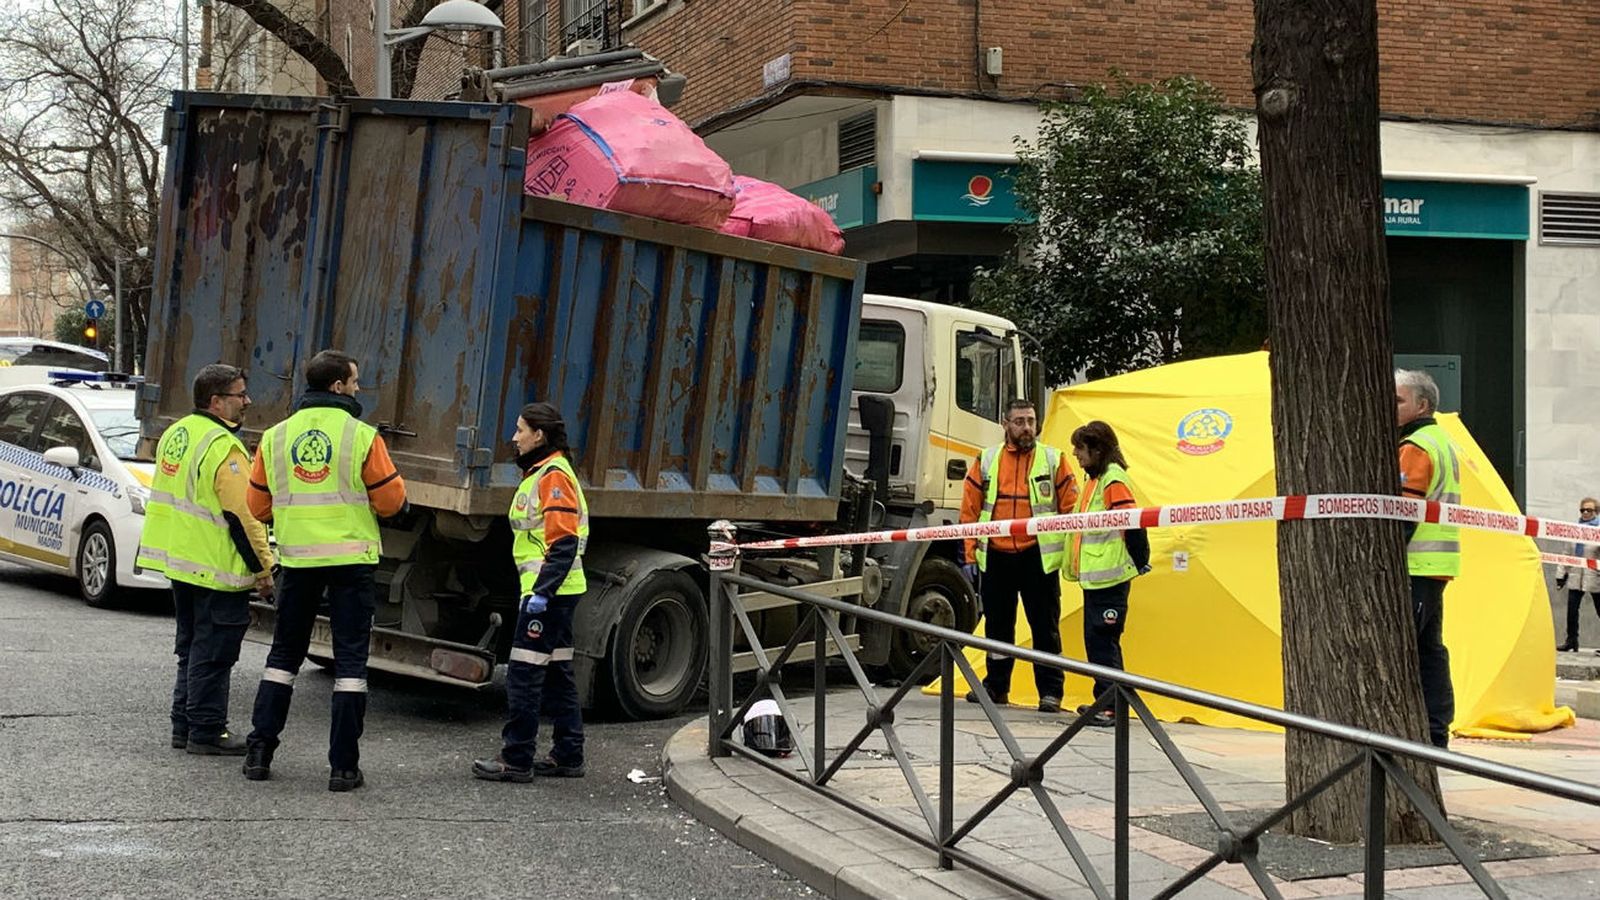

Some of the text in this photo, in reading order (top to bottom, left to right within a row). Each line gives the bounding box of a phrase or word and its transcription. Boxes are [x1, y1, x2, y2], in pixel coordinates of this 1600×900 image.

[1397, 216, 1422, 225] RURAL
[0, 478, 66, 521] OLICÍA
[1318, 498, 1419, 518] BOMBEROS NO PASAR
[1087, 514, 1099, 528] NO
[1102, 511, 1131, 527] PASAR
[1169, 501, 1273, 523] BOMBEROS NO PASAR
[1447, 507, 1485, 527] BOMBEROS
[15, 513, 64, 540] MUNICIPAL
